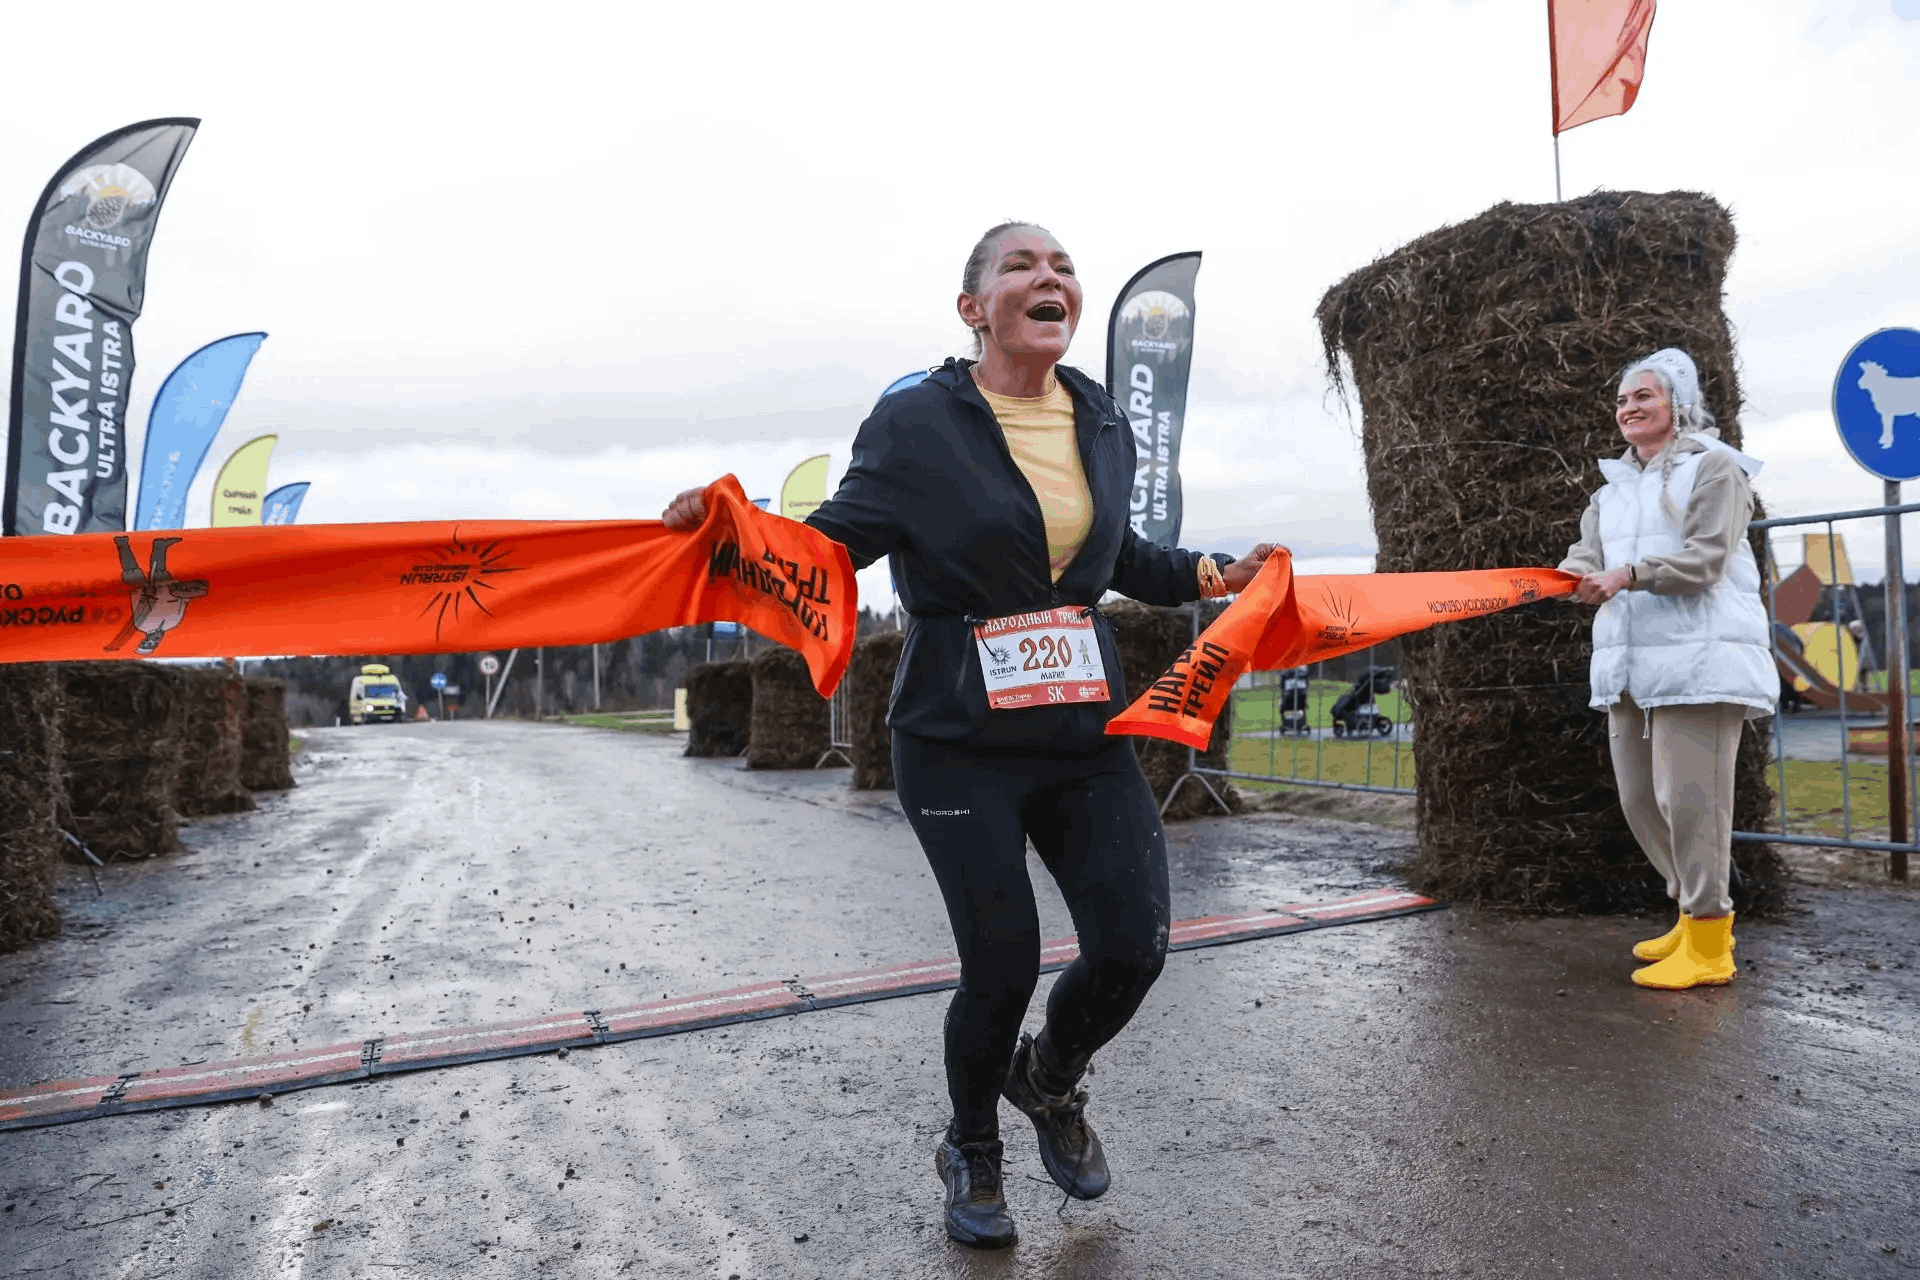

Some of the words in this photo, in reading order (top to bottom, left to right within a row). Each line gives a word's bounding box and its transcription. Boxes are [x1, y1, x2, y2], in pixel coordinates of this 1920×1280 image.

[65, 224, 131, 247] BACKYARD
[100, 320, 121, 396] ISTRA
[43, 261, 94, 535] BACKYARD
[96, 401, 116, 478] ULTRA
[1130, 363, 1153, 540] ACKYARD
[1156, 411, 1171, 463] ISTRA
[1153, 466, 1168, 521] ULTRA
[984, 611, 1053, 634] НАРОДНЫЙ
[989, 666, 1017, 677] ISTRUN
[1019, 635, 1072, 671] 220
[1182, 642, 1230, 718] ТРЕЙЛ
